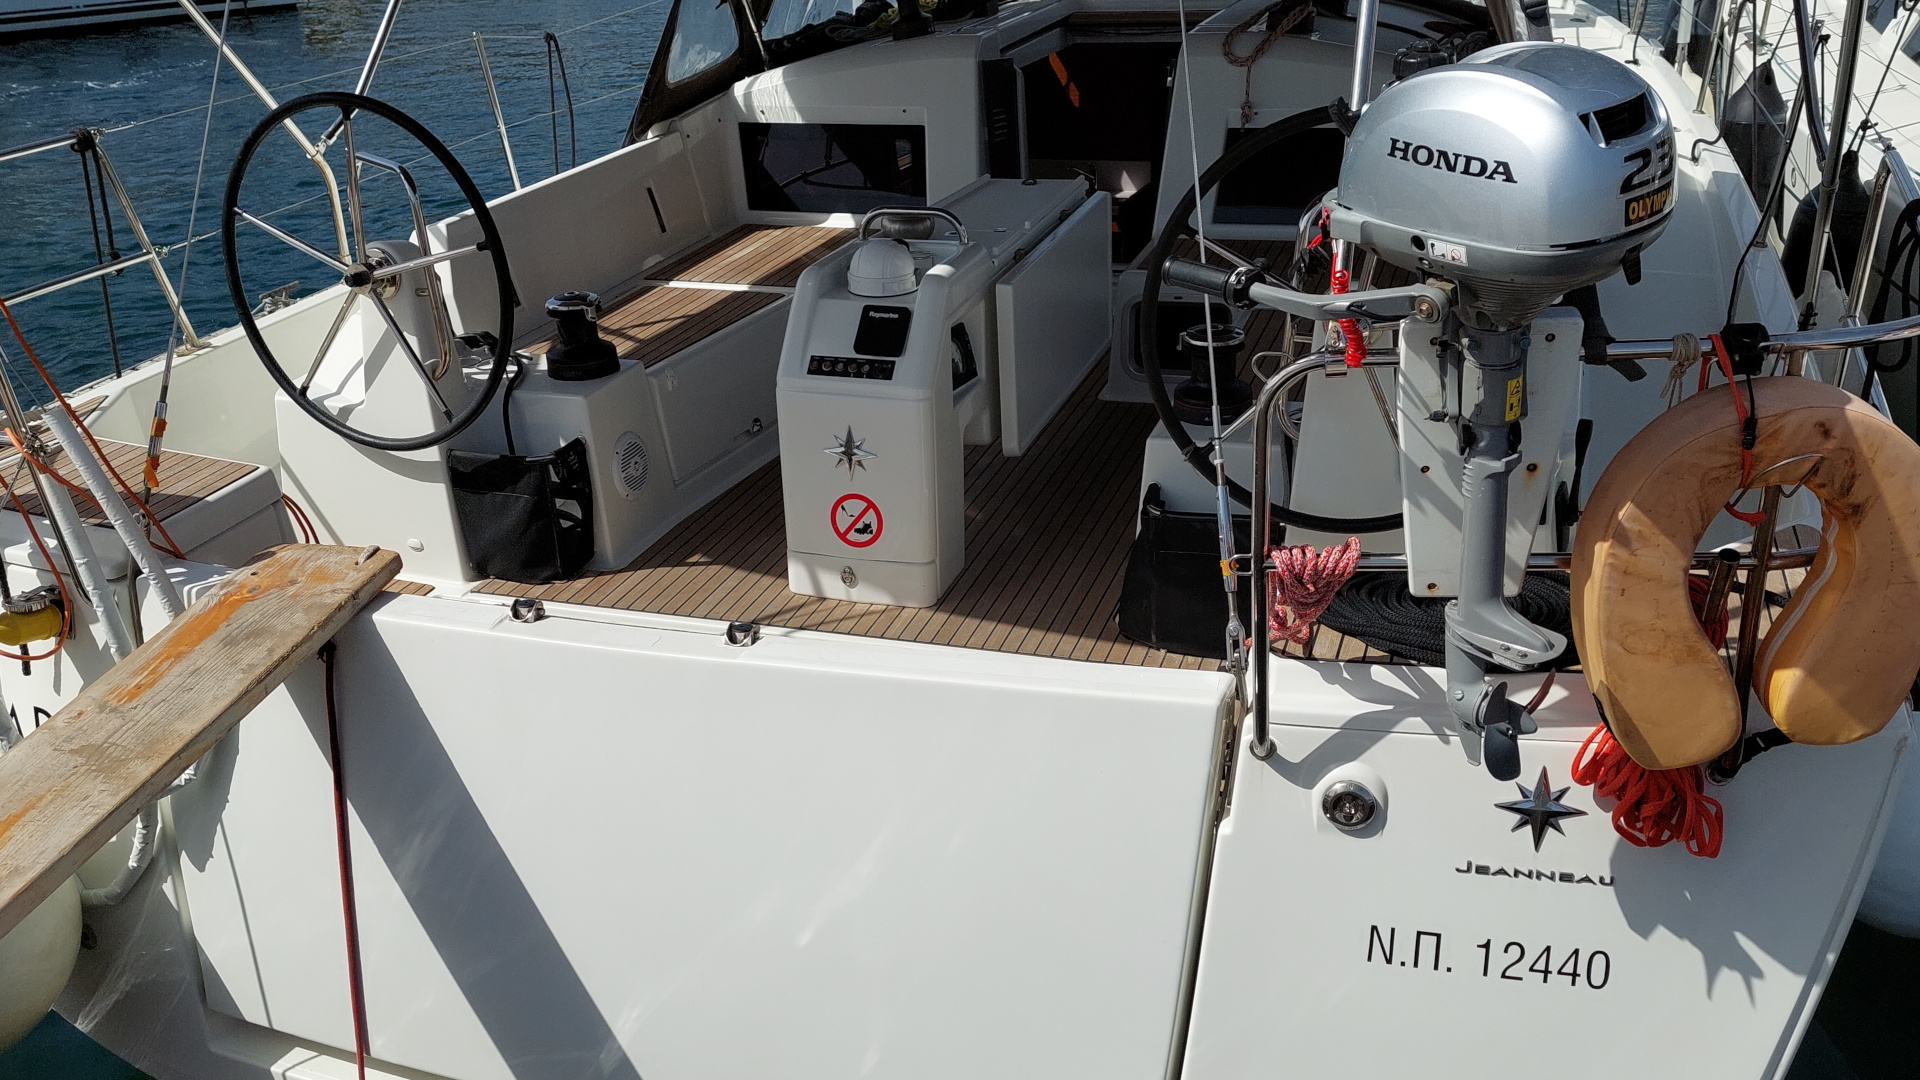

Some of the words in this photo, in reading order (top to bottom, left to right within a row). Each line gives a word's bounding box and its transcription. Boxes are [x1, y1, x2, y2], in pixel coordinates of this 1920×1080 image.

[1387, 137, 1518, 184] HONDA
[869, 311, 899, 319] Raymarine
[1455, 860, 1615, 887] JEANNEAU
[1477, 938, 1611, 989] 12440
